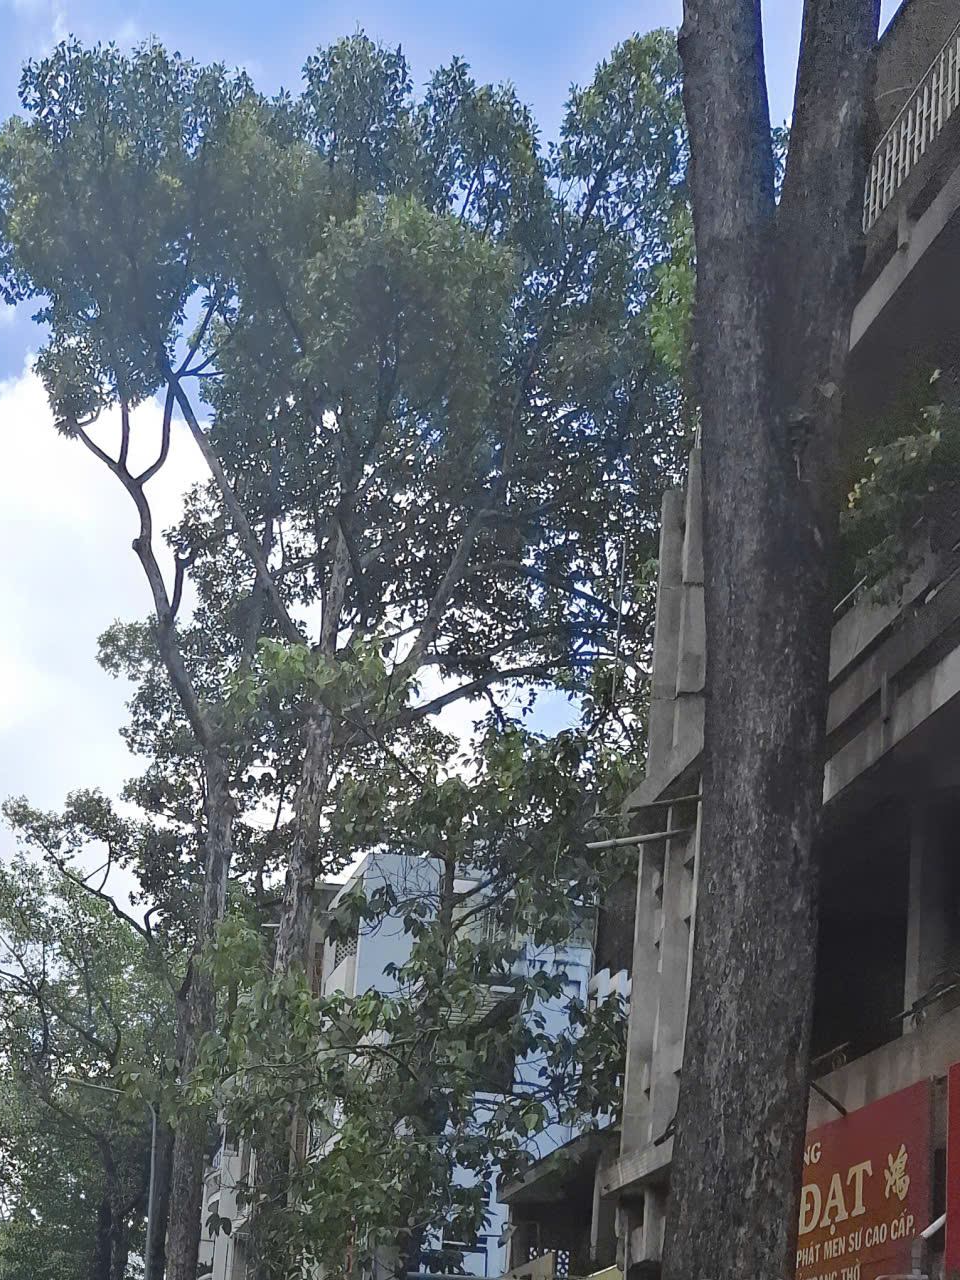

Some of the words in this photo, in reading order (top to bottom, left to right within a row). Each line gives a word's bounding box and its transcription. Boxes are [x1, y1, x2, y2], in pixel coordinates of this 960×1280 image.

[796, 1240, 821, 1270] PHẬT
[823, 1235, 846, 1261] MEN
[848, 1226, 863, 1253] SỨ
[865, 1223, 887, 1248] CAO
